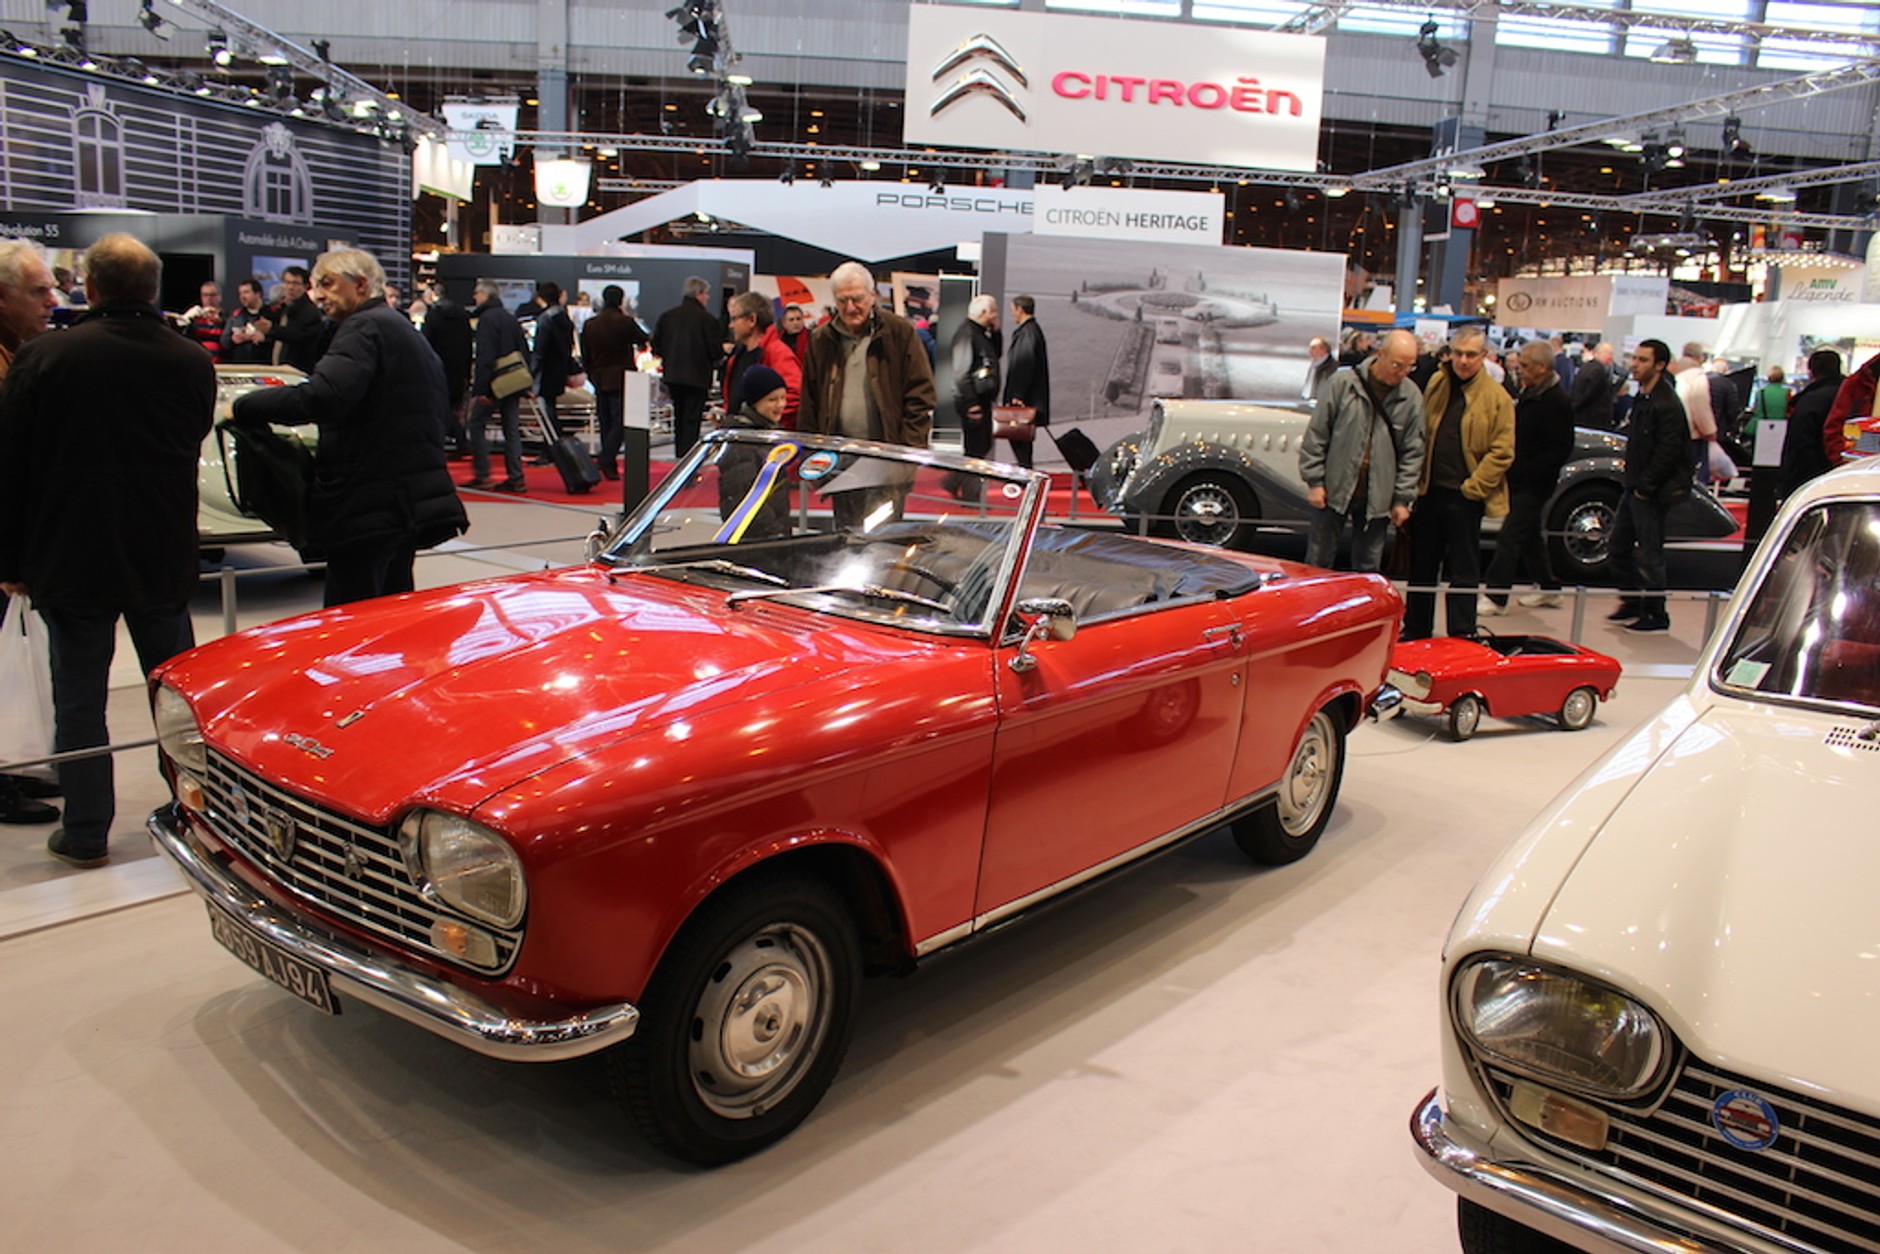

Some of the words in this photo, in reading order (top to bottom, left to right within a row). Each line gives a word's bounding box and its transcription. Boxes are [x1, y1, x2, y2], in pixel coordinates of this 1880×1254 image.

[1045, 206, 1121, 227] CITROËN
[1125, 211, 1209, 231] HERITAGE
[1550, 296, 1599, 307] AUCTIONS
